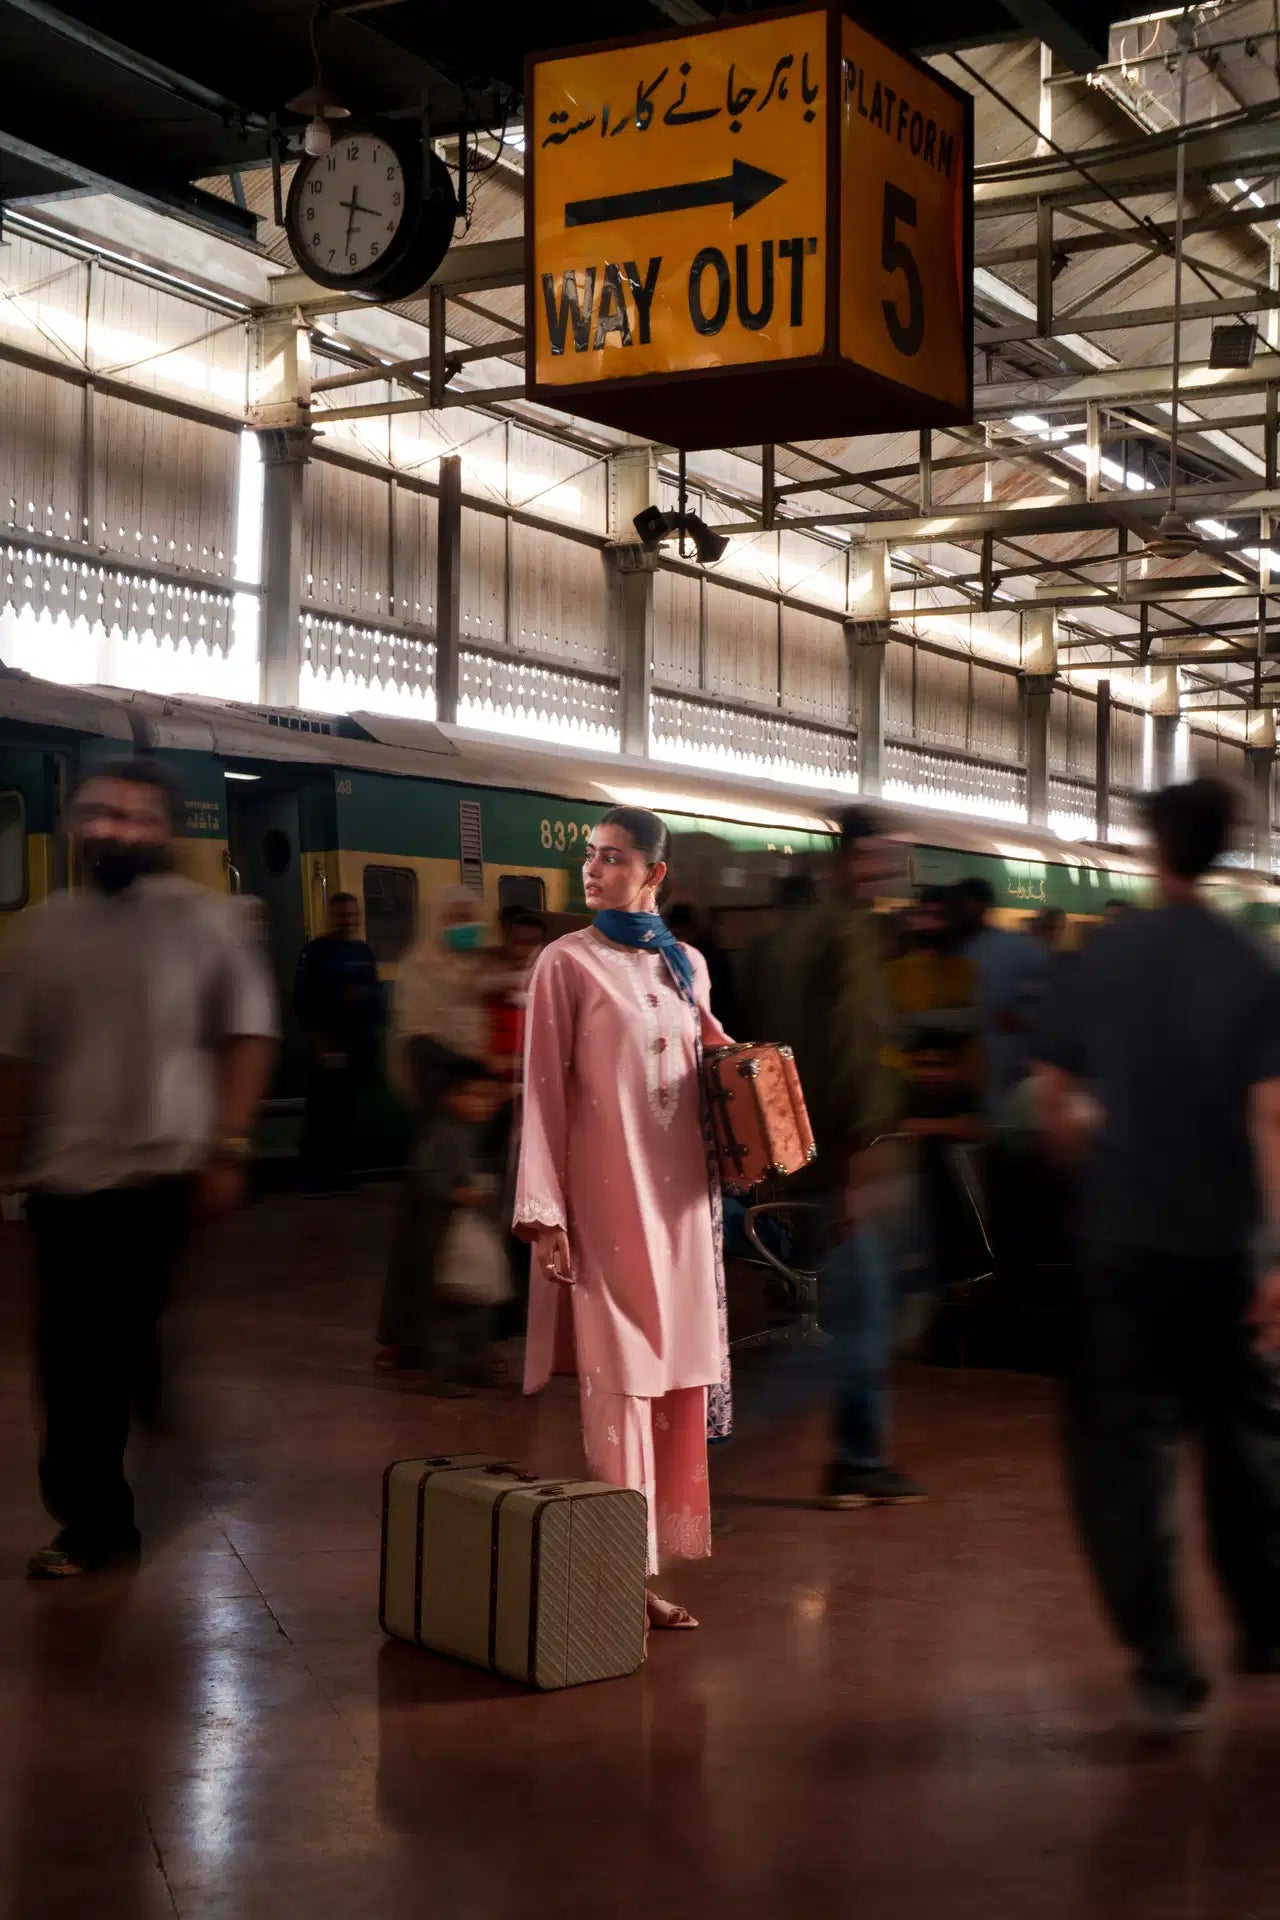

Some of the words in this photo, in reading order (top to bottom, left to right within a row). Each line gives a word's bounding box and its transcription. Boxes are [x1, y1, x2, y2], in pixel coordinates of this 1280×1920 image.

[843, 57, 954, 177] PLATFORM
[347, 147, 359, 161] 12
[372, 150, 378, 164] 1
[327, 158, 337, 171] 11
[386, 166, 396, 181] 2
[310, 180, 322, 194] 10
[392, 192, 400, 206] 3
[306, 207, 316, 221] 9
[386, 219, 395, 233] 4
[313, 233, 321, 246] 8
[370, 242, 379, 255] 5
[328, 249, 337, 264] 7
[881, 181, 925, 358] 5
[541, 256, 663, 356] WAY
[688, 236, 818, 336] OUT
